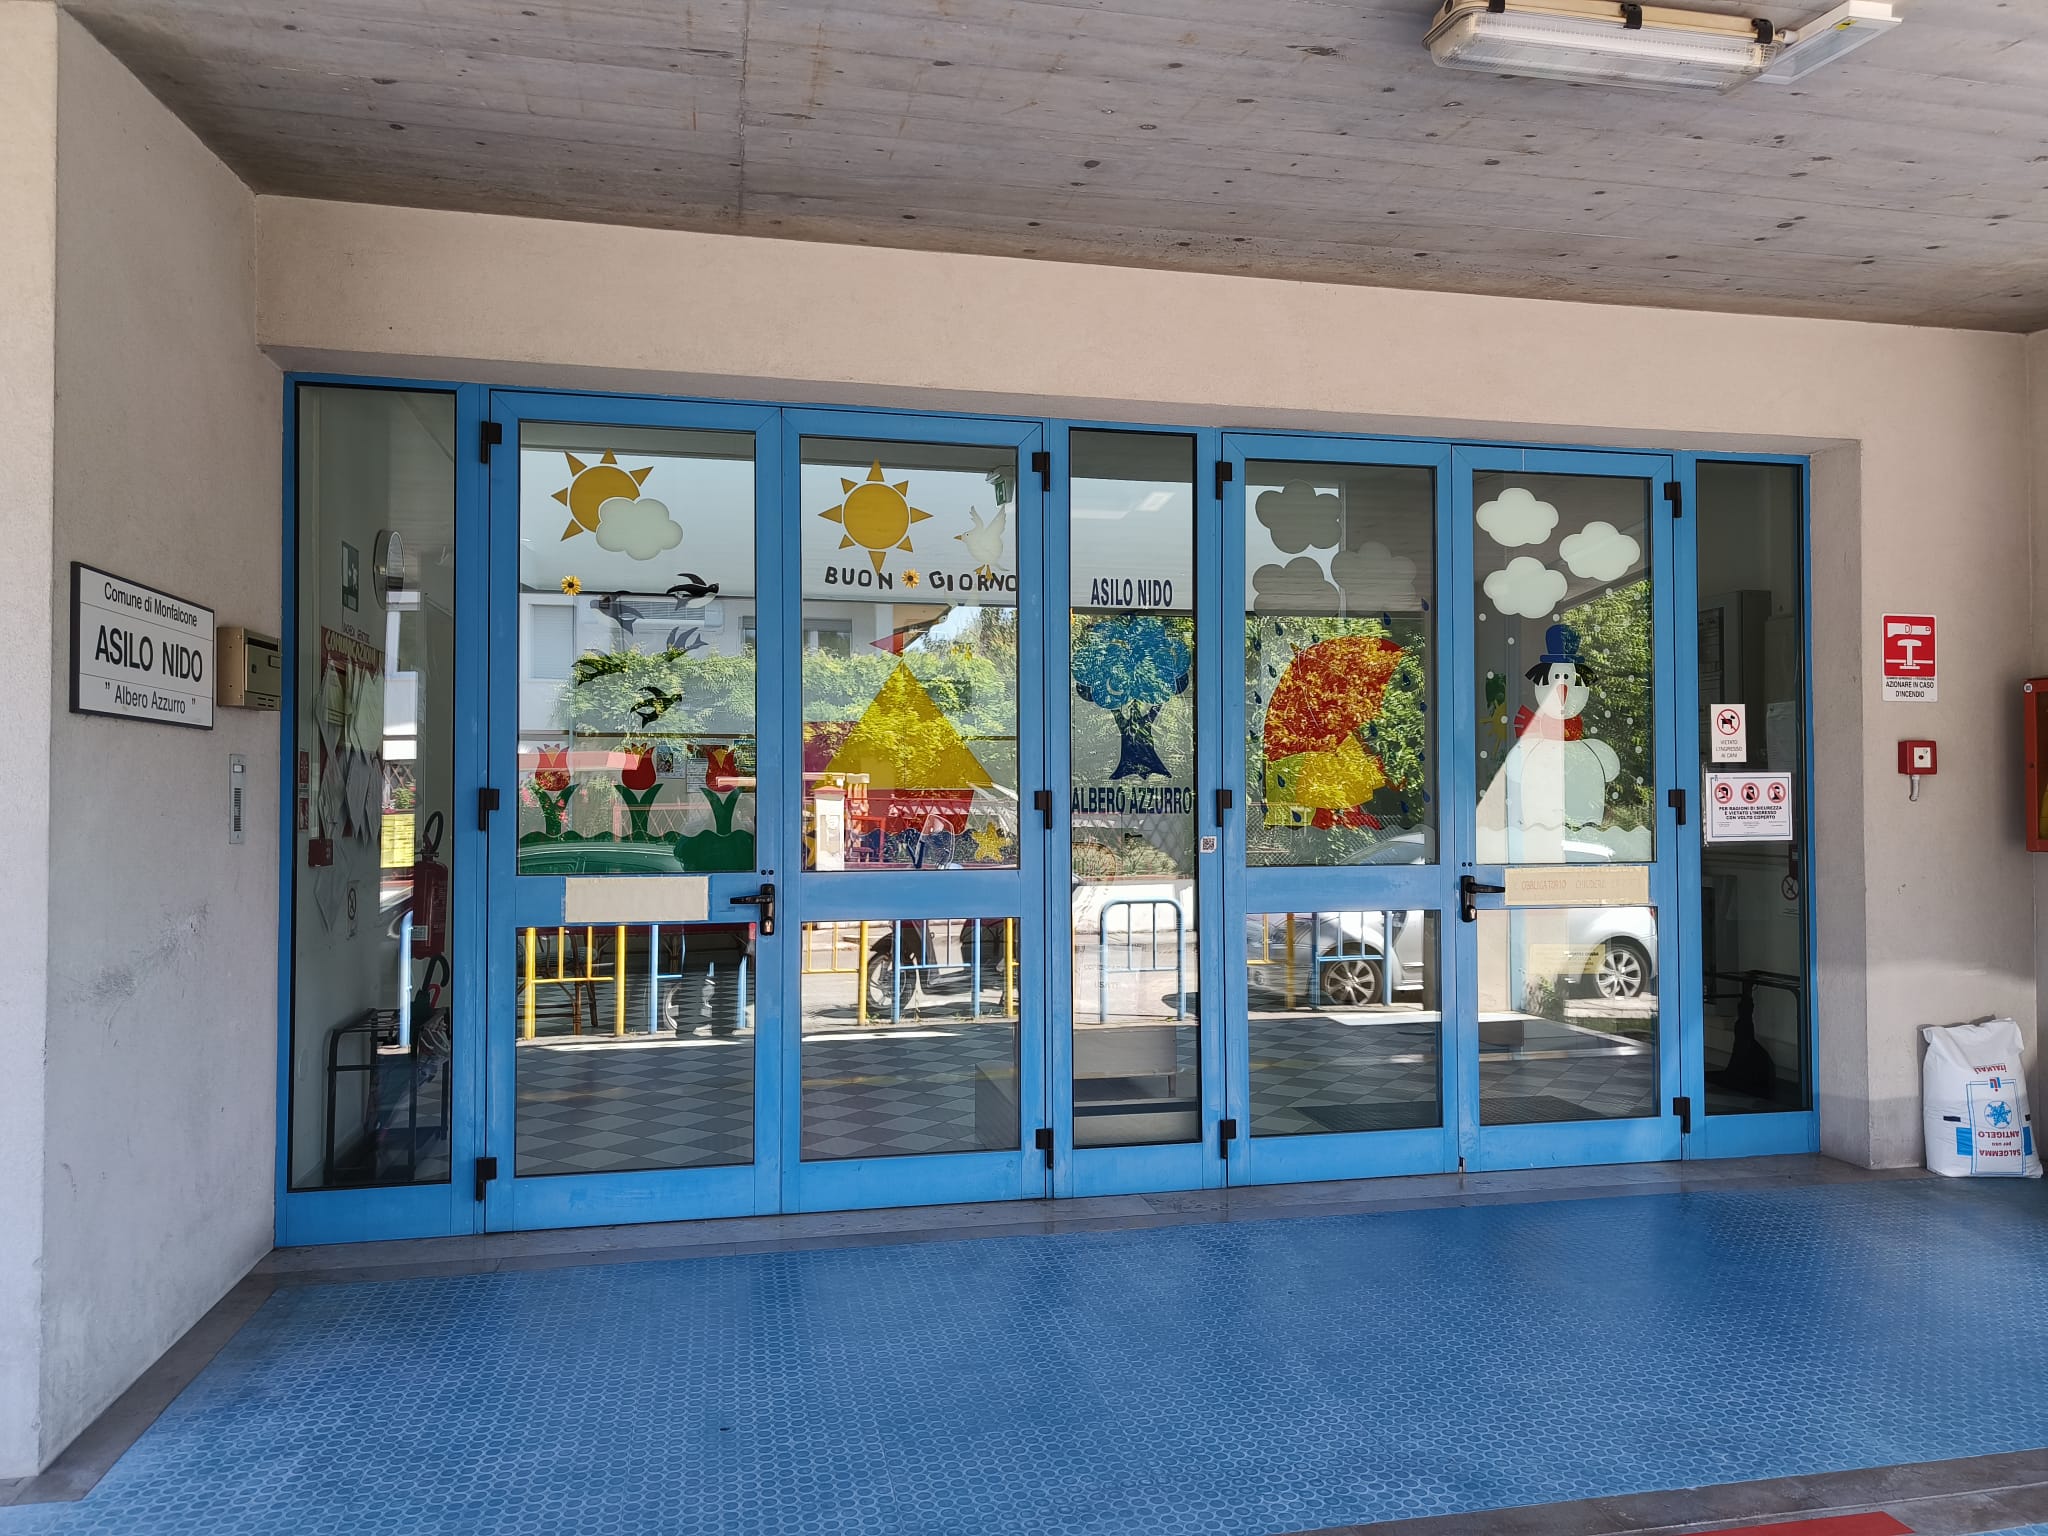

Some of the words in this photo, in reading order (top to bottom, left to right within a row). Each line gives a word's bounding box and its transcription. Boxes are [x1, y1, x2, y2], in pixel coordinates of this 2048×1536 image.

[824, 566, 893, 590] BUON
[929, 570, 1017, 592] GIORNO
[1091, 578, 1133, 606] ASILO
[1137, 579, 1173, 607] NIDO
[104, 582, 142, 610] Comune
[144, 596, 152, 612] di
[154, 598, 198, 627] Monfalcone
[95, 624, 153, 672] ASILO
[162, 641, 203, 682] NIDO
[115, 685, 148, 708] Albero
[151, 691, 186, 714] Azzurro
[1072, 787, 1126, 814] ALBERO
[1129, 787, 1192, 814] AZZURRO
[1978, 1130, 2020, 1139] ANTIGELO
[1979, 1149, 2022, 1157] SALGEMMA
